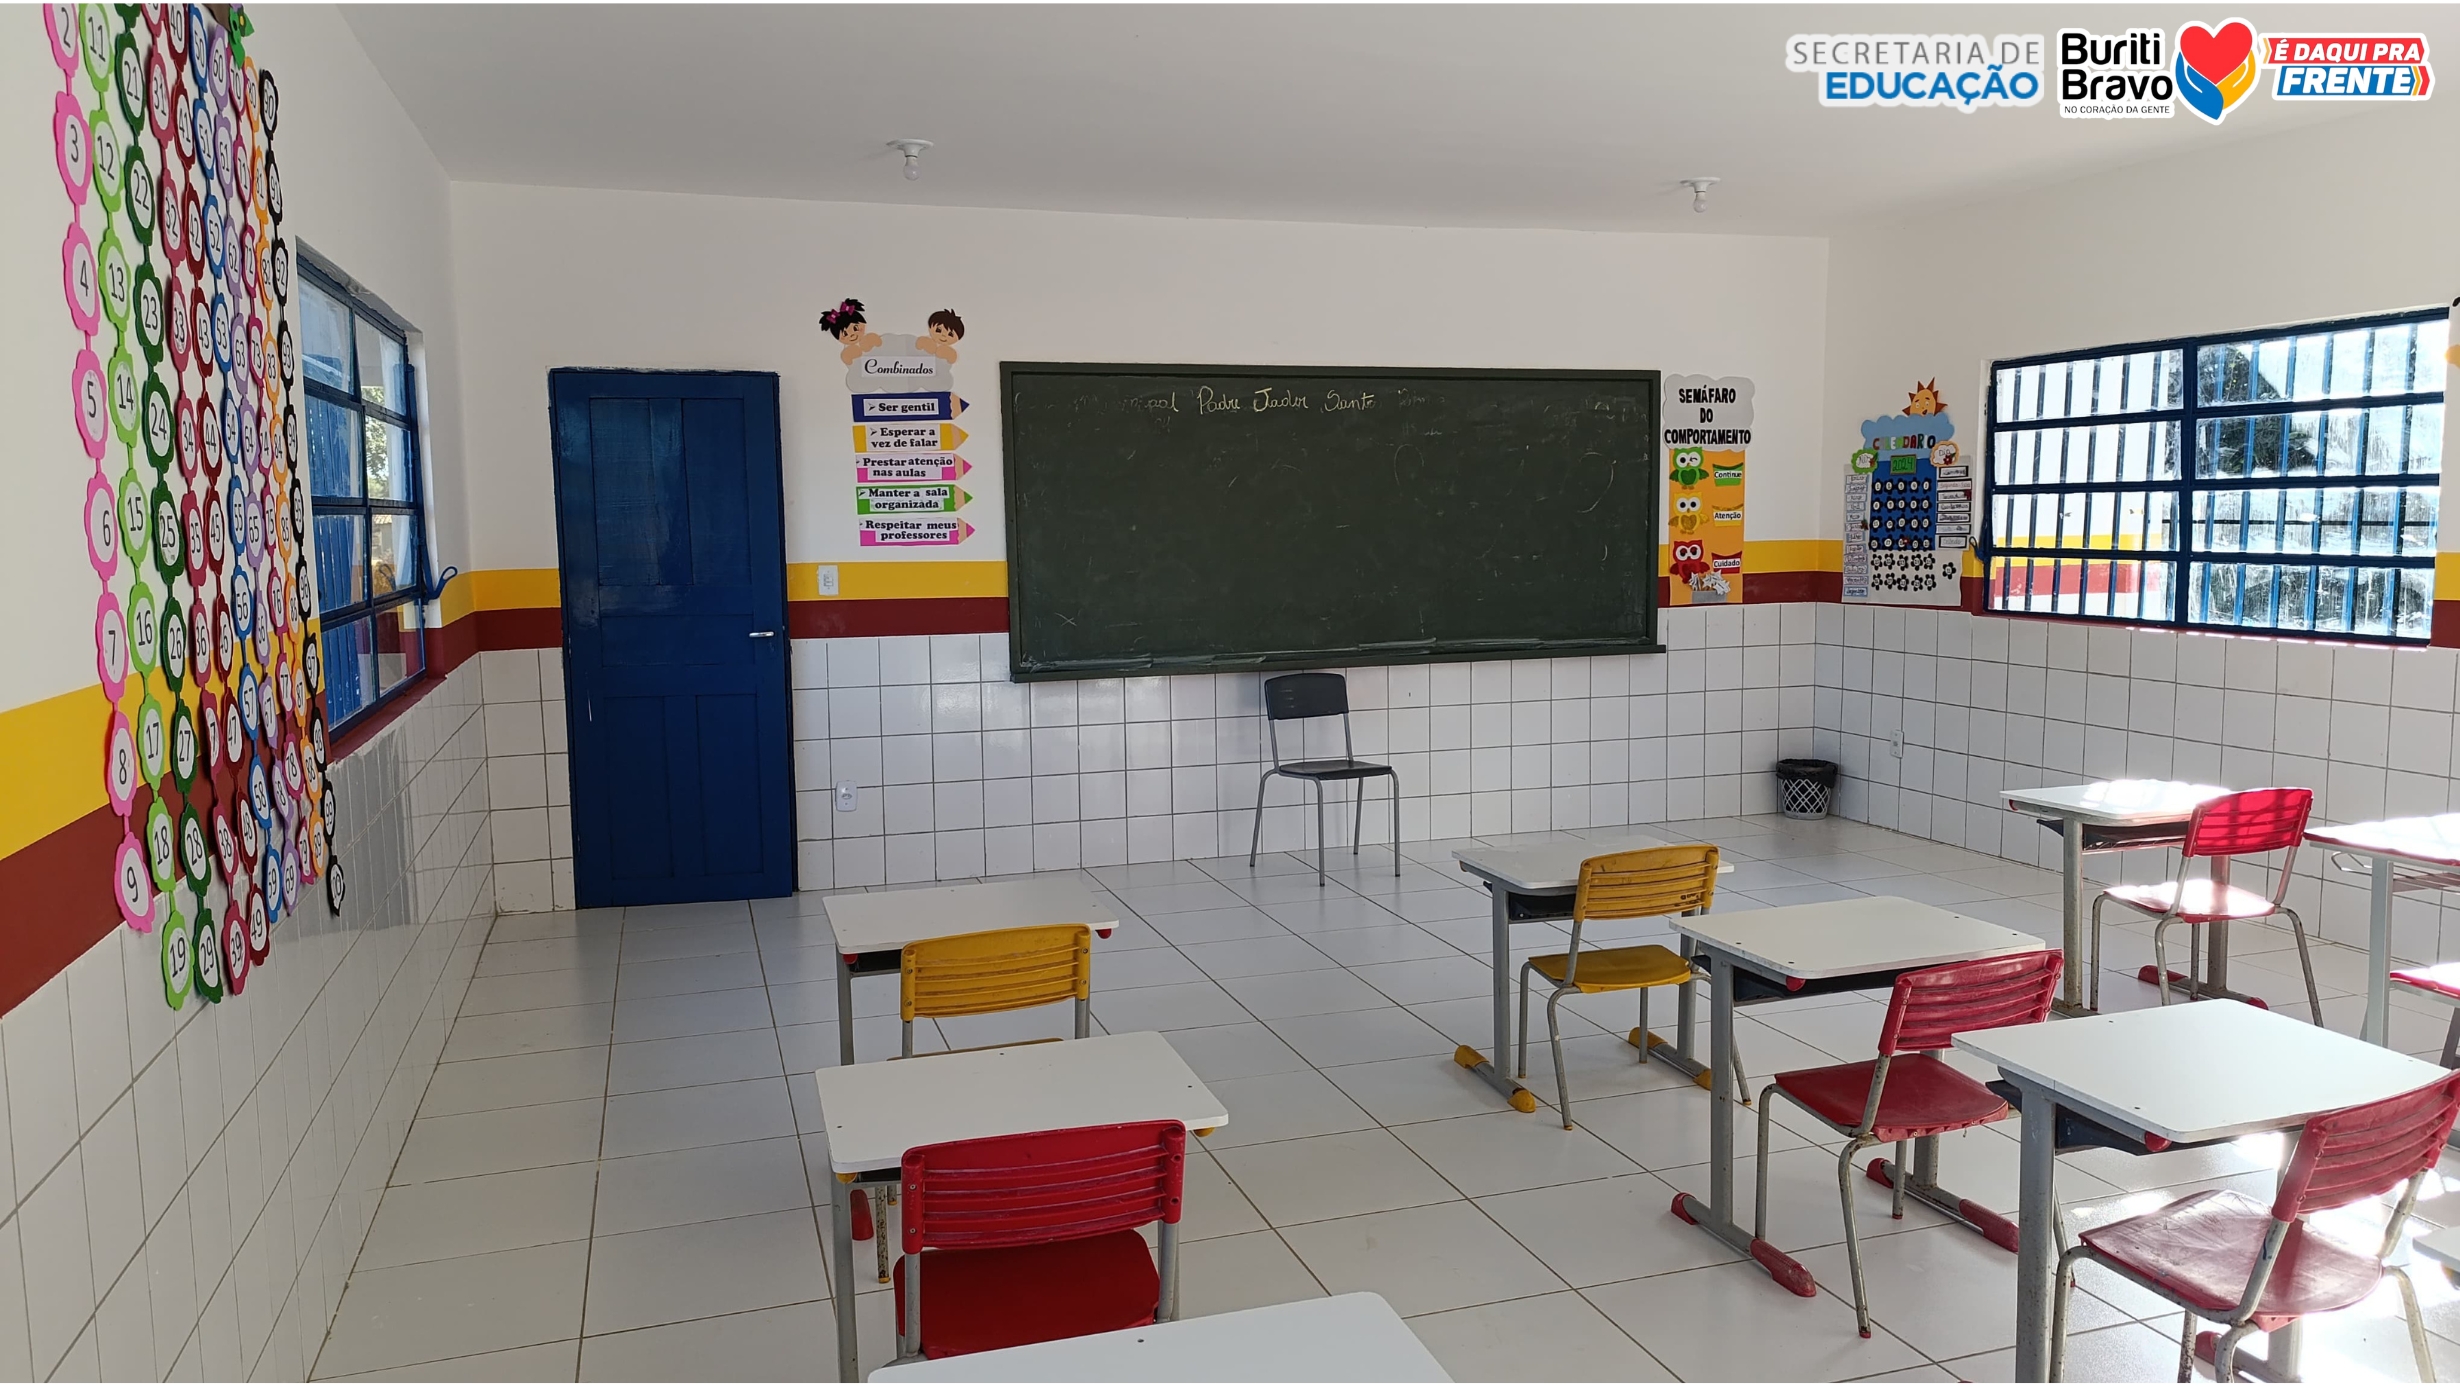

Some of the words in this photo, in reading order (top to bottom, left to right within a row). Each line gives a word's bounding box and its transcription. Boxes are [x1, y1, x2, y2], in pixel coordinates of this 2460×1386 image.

[61, 7, 71, 48] 2
[171, 4, 183, 42] 40
[88, 16, 106, 62] 11
[194, 30, 205, 68] 50
[124, 61, 141, 101] 21
[213, 49, 224, 83] 60
[153, 77, 167, 117] 31
[231, 68, 241, 100] 70
[264, 88, 274, 120] 90
[180, 108, 191, 143] 41
[70, 124, 79, 162] 3
[199, 124, 212, 159] 51
[220, 142, 230, 172] 61
[97, 135, 115, 180] 12
[134, 169, 150, 210] 22
[238, 158, 248, 190] 71
[256, 168, 264, 199] 81
[270, 175, 281, 206] 91
[165, 196, 179, 238] 32
[190, 214, 201, 248] 42
[209, 219, 221, 252] 52
[229, 242, 239, 273] 62
[245, 245, 253, 275] 72
[276, 257, 286, 287] 92
[80, 260, 88, 297] 4
[109, 263, 125, 302] 13
[143, 295, 158, 329] 23
[174, 308, 185, 343] 33
[199, 318, 210, 349] 43
[216, 317, 228, 349] 53
[235, 340, 246, 369] 63
[252, 340, 261, 369] 73
[267, 353, 277, 379] 83
[283, 341, 292, 369] 93
[864, 358, 933, 374] Combinados
[87, 380, 97, 418] 5
[117, 374, 134, 410] 14
[878, 402, 898, 411] Ser
[901, 402, 935, 413] gentil
[1679, 384, 1736, 403] SEMÁFARO
[151, 402, 167, 440] 24
[226, 413, 236, 441] 54
[1700, 407, 1713, 423] DO
[183, 421, 194, 453] 34
[205, 422, 217, 453] 44
[245, 426, 254, 455] 64
[274, 433, 283, 459] 84
[289, 423, 297, 449] 94
[880, 427, 926, 437] Esperar
[929, 428, 935, 436] a
[893, 438, 907, 447] de
[910, 438, 938, 446] falar
[1664, 428, 1751, 444] COMPORTAMENTO
[863, 457, 907, 466] Prestar
[908, 457, 952, 467] atenção
[873, 469, 893, 477] nas
[895, 468, 926, 477] aulas
[1892, 458, 1913, 471] 2024
[869, 488, 911, 497] Manter
[925, 488, 948, 496] sala
[875, 500, 939, 510] organizada
[102, 510, 111, 547] 6
[128, 497, 143, 531] 15
[210, 513, 220, 543] 45
[249, 516, 260, 543] 65
[266, 508, 274, 534] 75
[281, 516, 290, 542] 85
[865, 520, 922, 530] Respeitar
[1714, 512, 1741, 520] Atenção
[159, 515, 176, 548] 25
[191, 522, 202, 553] 35
[881, 531, 948, 540] professores
[236, 592, 249, 622] 56
[136, 610, 152, 646] 16
[169, 627, 182, 660] 26
[108, 630, 116, 666] 7
[307, 656, 317, 682] 97
[243, 687, 254, 718] 57
[280, 674, 289, 700] 77
[146, 722, 159, 759] 17
[179, 730, 191, 761] 27
[228, 716, 238, 747] 47
[119, 749, 127, 785] 8
[287, 753, 299, 782] 78
[305, 757, 317, 783] 88
[253, 781, 267, 811] 58
[325, 801, 333, 827] 99
[154, 826, 170, 865] 18
[186, 828, 203, 865] 28
[218, 827, 233, 860] 38
[313, 832, 323, 858] 89
[127, 866, 139, 903] 9
[285, 865, 295, 895] 69
[251, 909, 263, 940] 49
[170, 937, 186, 978] 19
[200, 936, 215, 975] 29
[230, 931, 243, 967] 39
